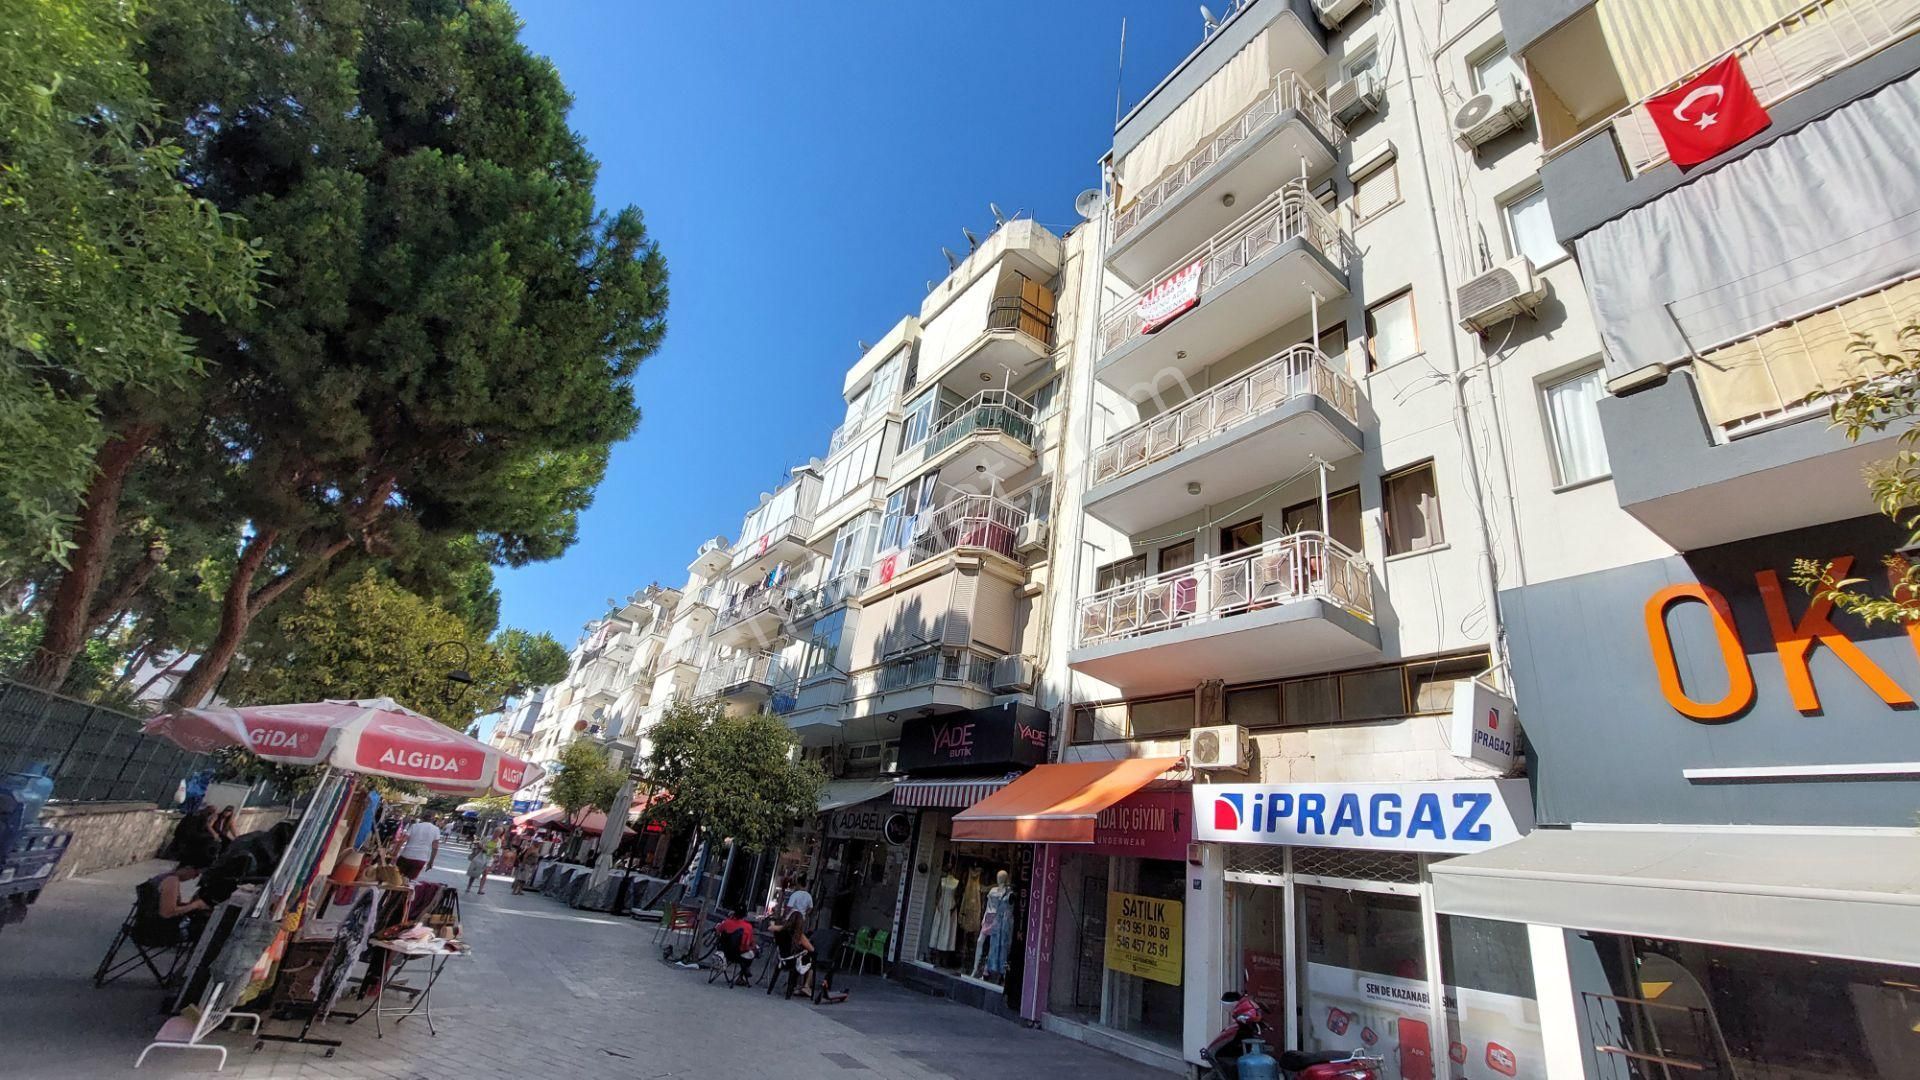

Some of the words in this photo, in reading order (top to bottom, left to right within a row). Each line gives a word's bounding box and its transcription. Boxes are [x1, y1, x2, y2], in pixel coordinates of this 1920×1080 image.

[931, 721, 976, 755] YADE
[1017, 719, 1047, 743] YADE
[1118, 803, 1130, 834] İÇ
[1132, 802, 1166, 832] GİYİM
[1097, 834, 1146, 847] UNDERWEAR
[1132, 921, 1146, 936] 951
[1147, 924, 1158, 938] 80
[1131, 938, 1146, 953] 457
[1147, 941, 1158, 956] 25
[1158, 943, 1169, 958] 91
[1366, 982, 1380, 996] SEN
[1380, 985, 1391, 997] DE
